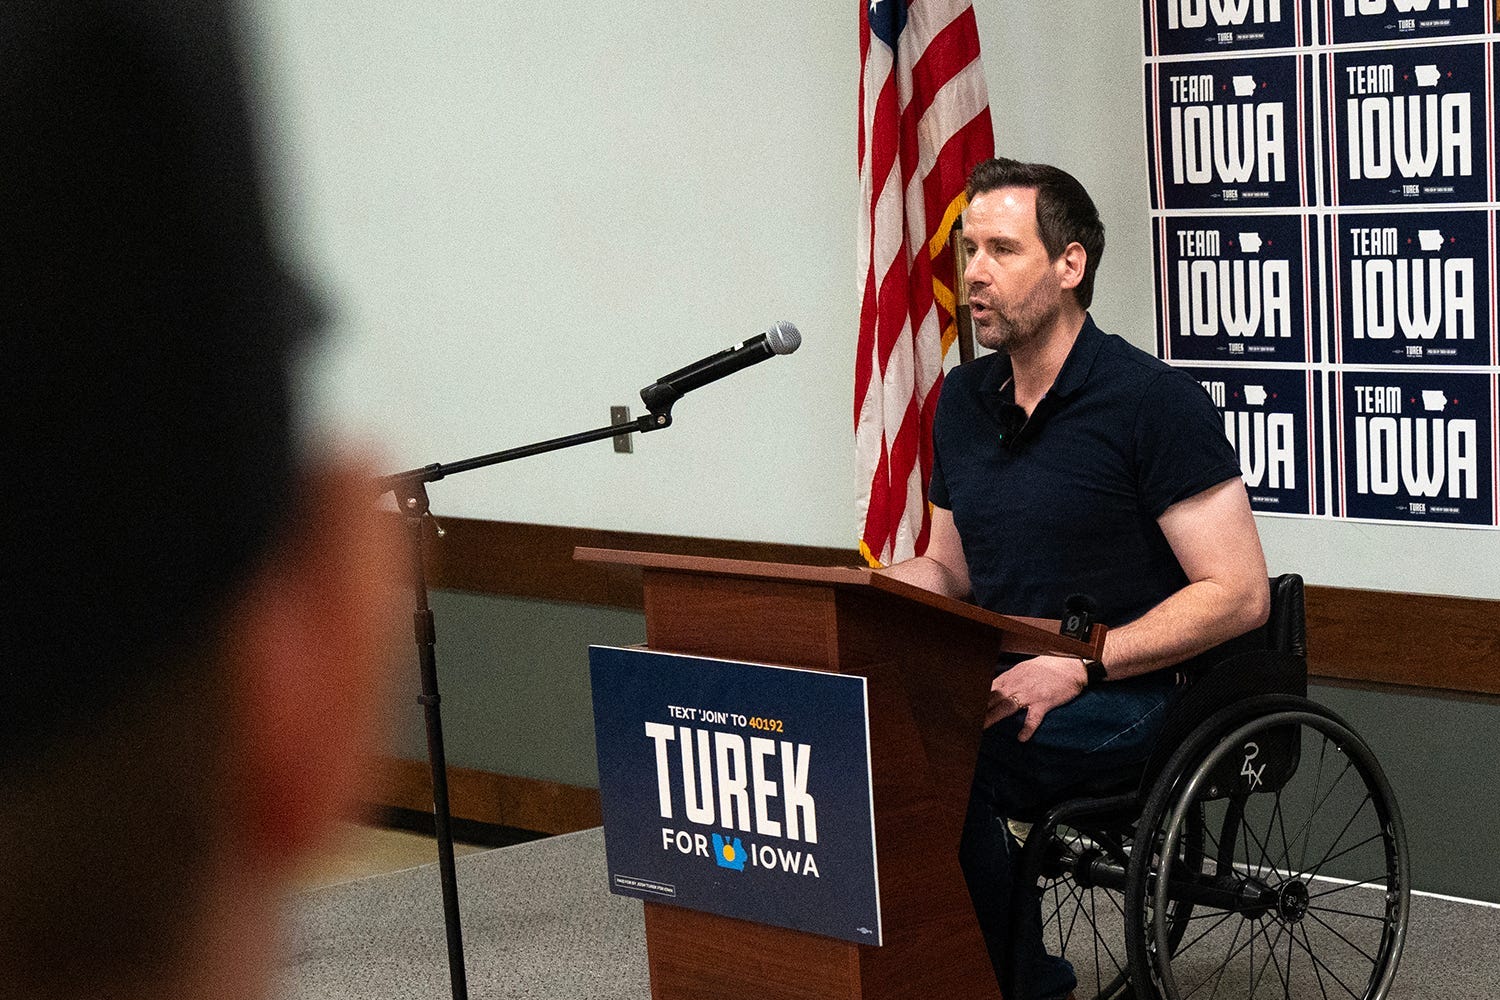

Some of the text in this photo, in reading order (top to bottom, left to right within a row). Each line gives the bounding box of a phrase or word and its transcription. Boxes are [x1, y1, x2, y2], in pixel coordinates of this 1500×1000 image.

[1170, 75, 1214, 103] TEAM
[1346, 65, 1394, 94] TEAM
[1170, 102, 1286, 185] IOWA
[1347, 93, 1472, 180] IOWA
[1177, 230, 1221, 257] TEAM
[1350, 228, 1398, 256] TEAM
[1177, 259, 1292, 338] IOWA
[1350, 258, 1475, 340] IOWA
[1354, 386, 1402, 414] TEAM
[1224, 410, 1296, 490] WA
[1355, 416, 1478, 499] IOWA
[667, 704, 697, 721] TEXT
[730, 713, 748, 728] TO
[748, 716, 784, 733] 40192
[644, 721, 819, 845] TUREK
[661, 827, 820, 878] FOR IOWA
